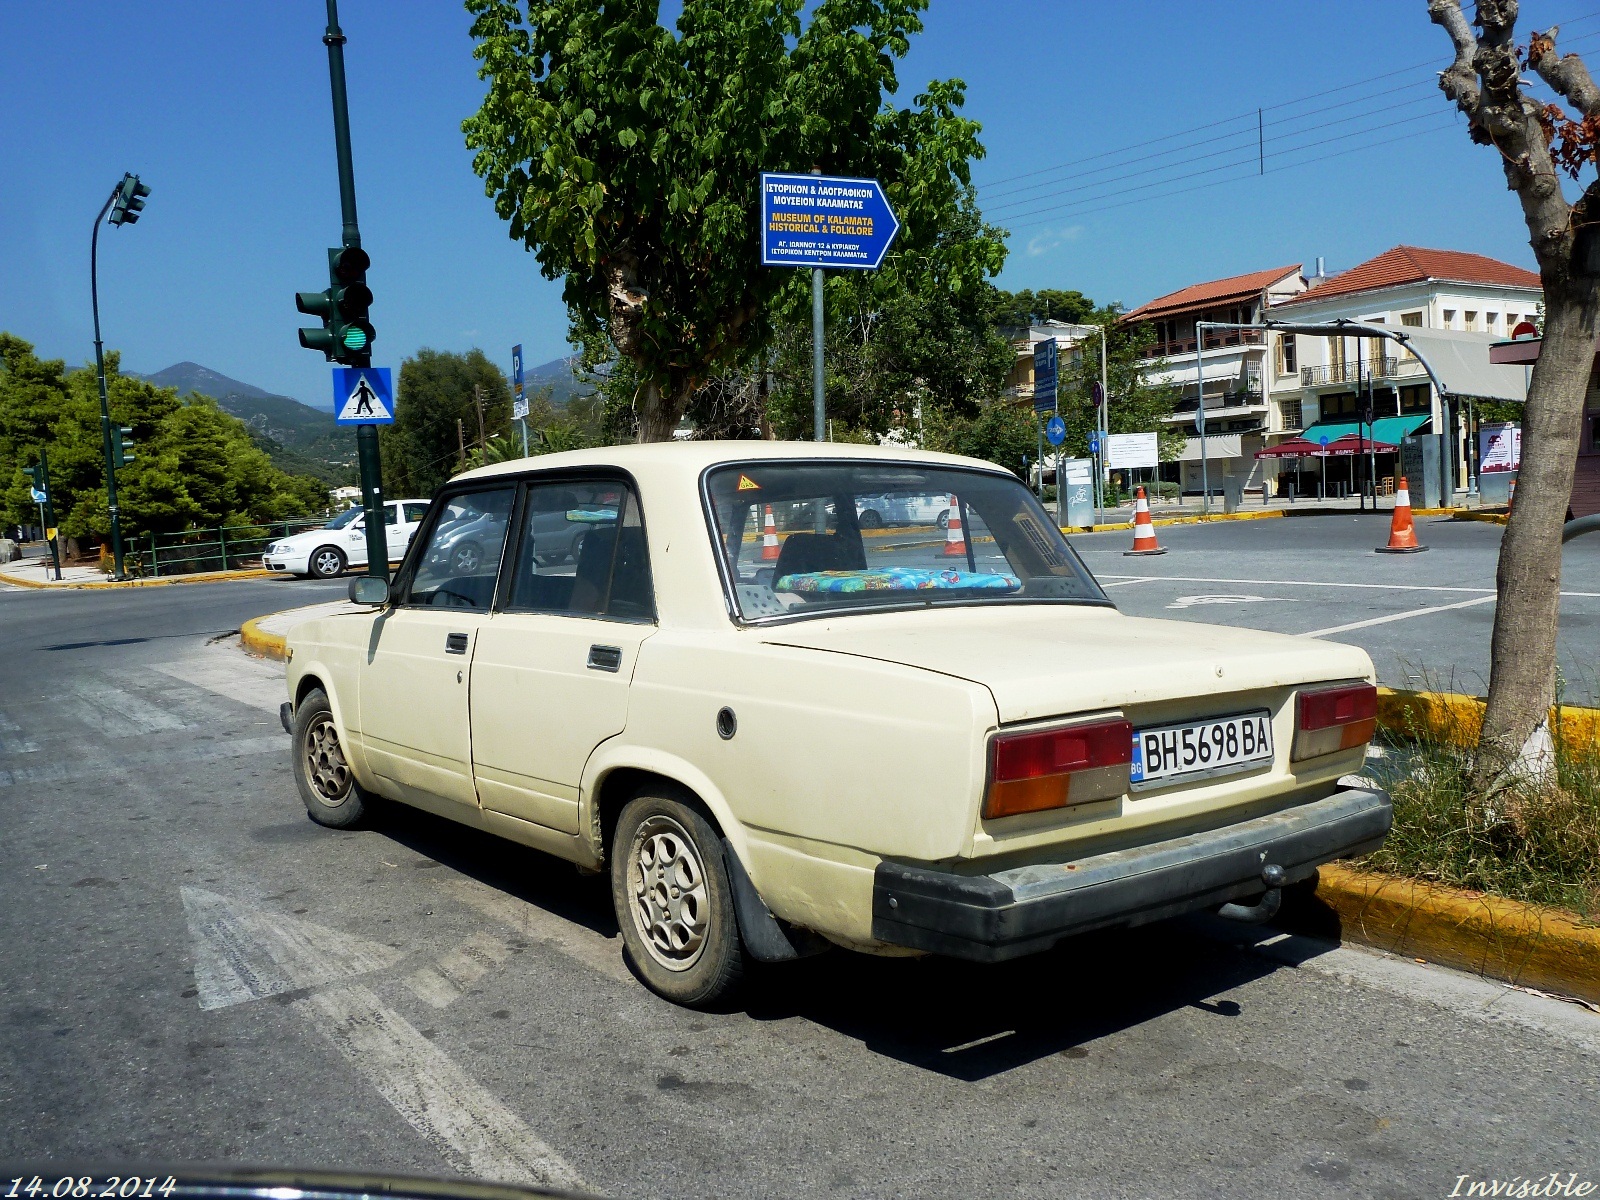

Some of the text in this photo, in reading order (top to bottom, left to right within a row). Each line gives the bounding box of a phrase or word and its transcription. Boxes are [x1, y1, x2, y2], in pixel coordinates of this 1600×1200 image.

[766, 184, 873, 198] ΙΣΤΟΡΙΚΟΝ & ΛΑΟΓΡΑΦΙΚΟΝ
[773, 196, 864, 209] ΜΟΥΣΕΙΟΝ ΚΑΛΑΜΑΤΑΣ
[772, 212, 873, 226] MUSEUM OF KALAMATA
[769, 222, 873, 236] HISTORICAL & FOLKLORE
[1130, 763, 1142, 775] BG
